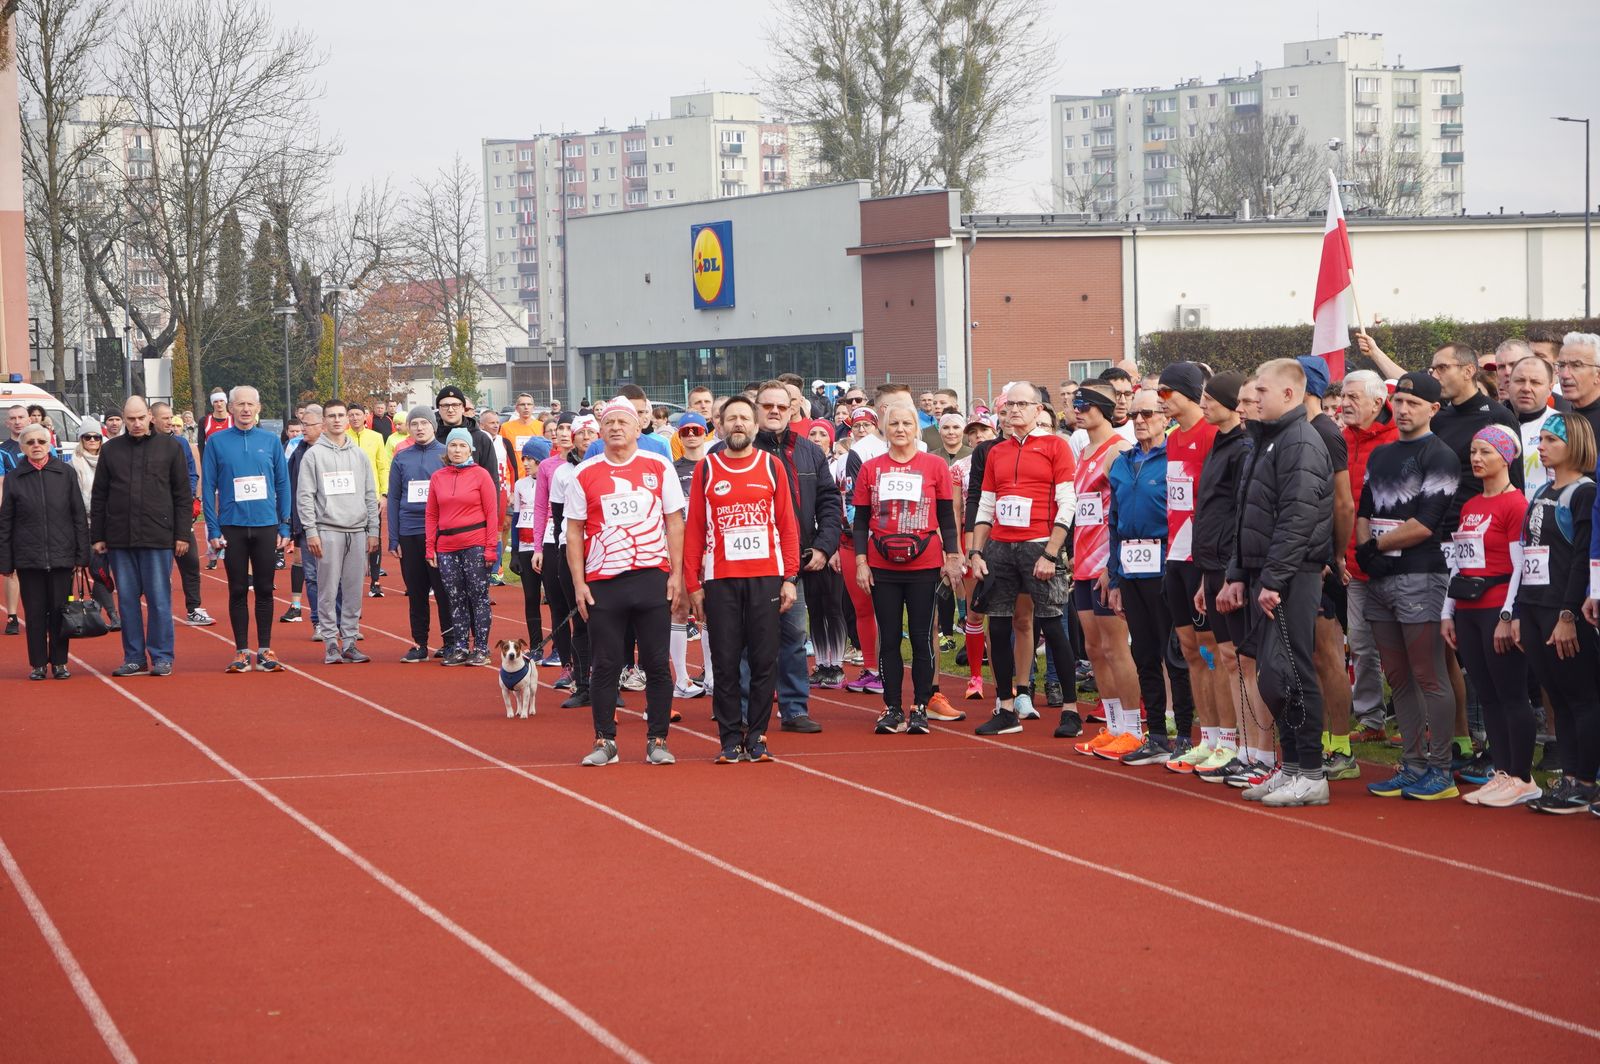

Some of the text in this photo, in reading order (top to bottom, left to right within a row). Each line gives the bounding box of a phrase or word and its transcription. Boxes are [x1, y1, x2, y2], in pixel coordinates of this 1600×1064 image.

[243, 483, 258, 493] 95
[331, 479, 349, 488] 159
[887, 480, 913, 491] 559
[610, 500, 638, 516] 339
[716, 502, 761, 515] DRUŻYNA
[1000, 503, 1021, 517] 311
[1078, 503, 1095, 516] 62
[522, 511, 534, 521] 97
[717, 511, 769, 530] SZPIKU
[733, 536, 761, 550] 405
[1126, 548, 1152, 563] 329
[1458, 543, 1475, 558] 236
